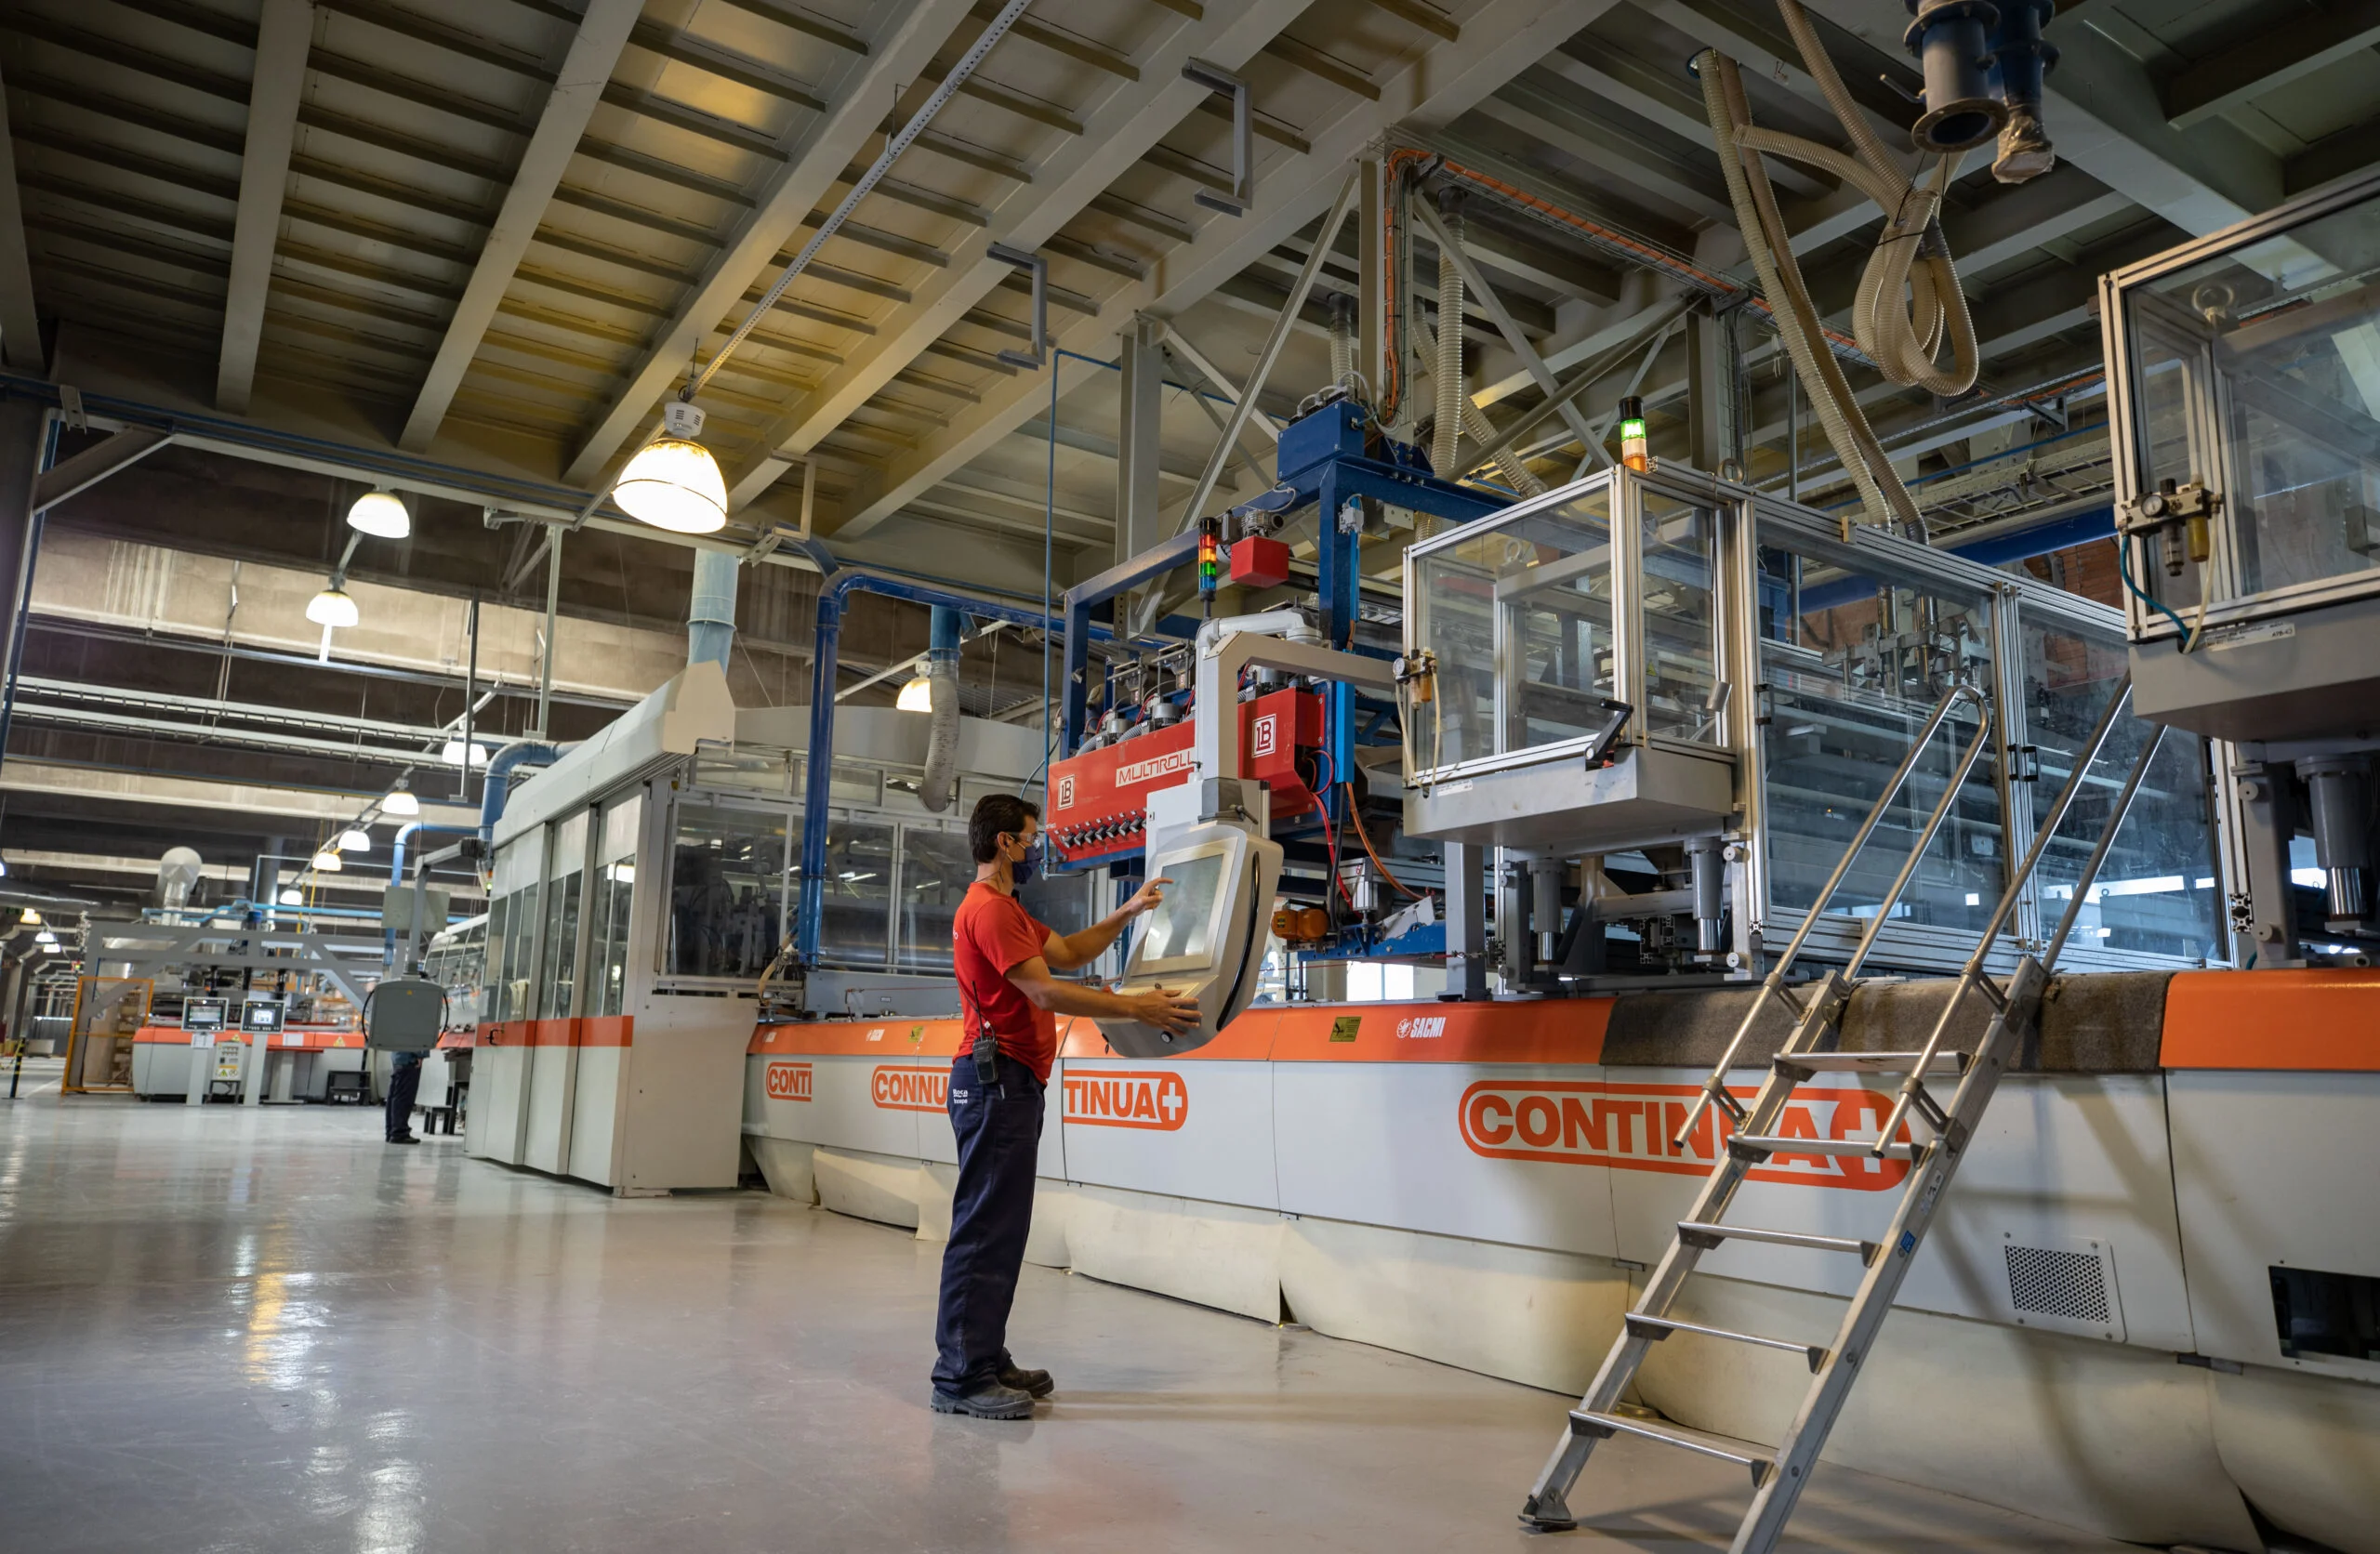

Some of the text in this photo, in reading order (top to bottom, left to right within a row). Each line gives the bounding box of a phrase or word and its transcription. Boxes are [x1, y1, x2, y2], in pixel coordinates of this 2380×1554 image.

[1118, 750, 1193, 784] MULTIROLL
[1410, 1017, 1447, 1038] SACMI
[769, 1069, 812, 1095] CONTI
